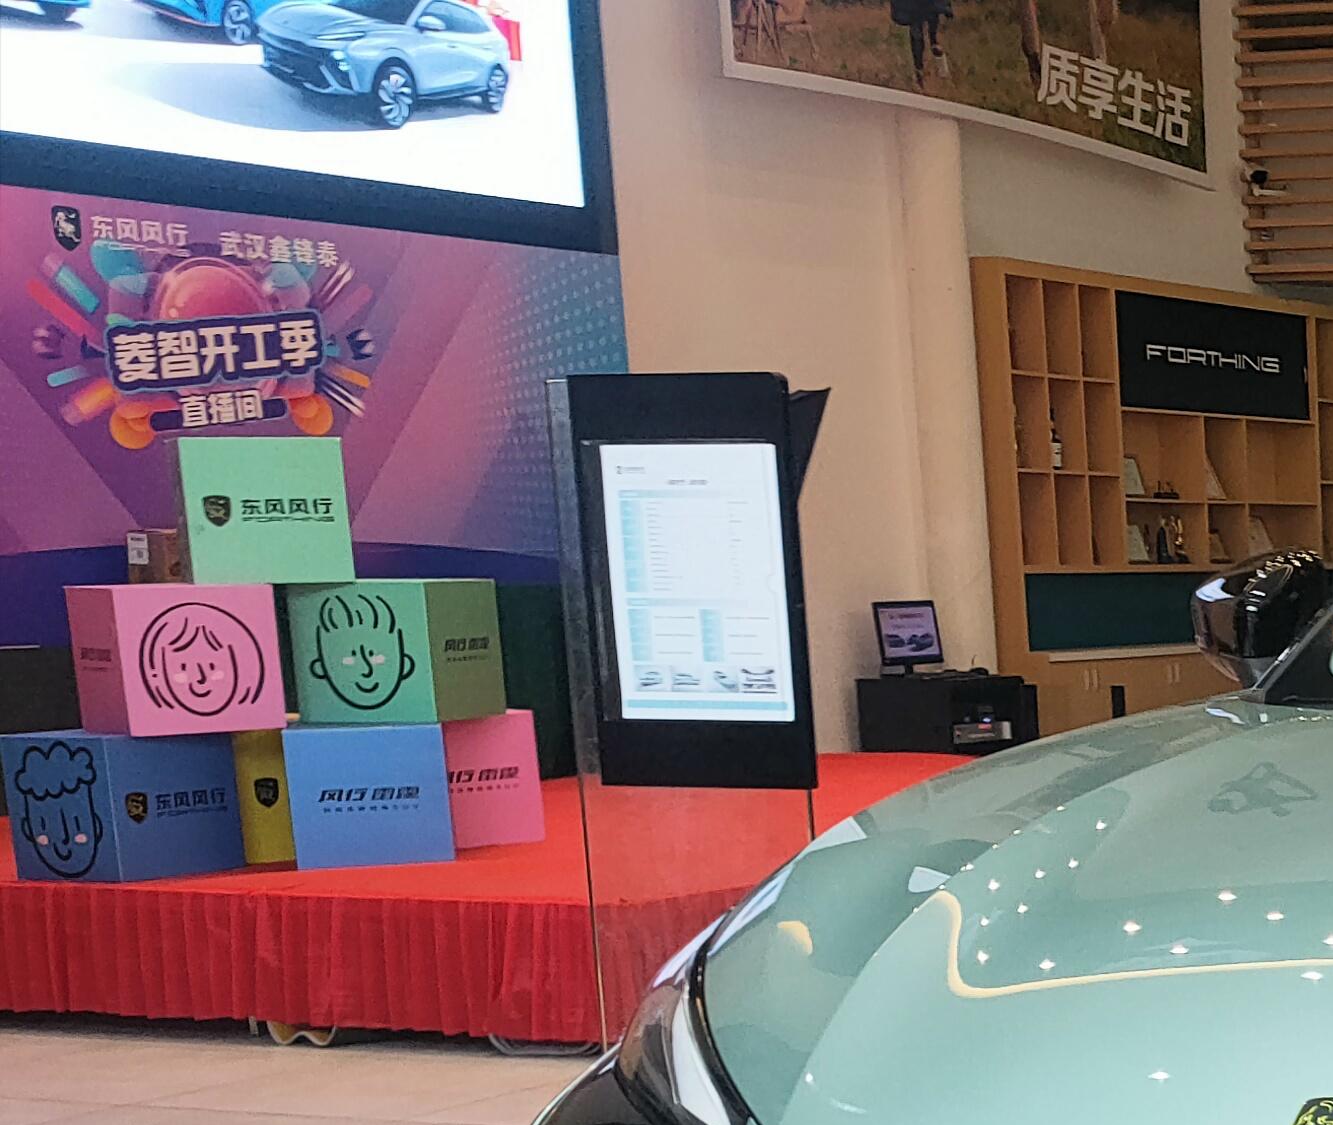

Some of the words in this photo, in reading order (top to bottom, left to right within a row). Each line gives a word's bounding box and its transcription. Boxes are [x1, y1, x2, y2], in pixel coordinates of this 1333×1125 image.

[1037, 42, 1192, 147] 质享生活
[91, 215, 188, 246] 东风风行
[219, 230, 339, 268] 武汉鑫锋泰
[112, 319, 318, 383] 菱智开工季
[1145, 344, 1281, 374] FORTHING
[179, 389, 263, 427] 直播间
[240, 498, 334, 515] 东风风行
[155, 788, 226, 810] 东风风行
[318, 788, 368, 803] 风行
